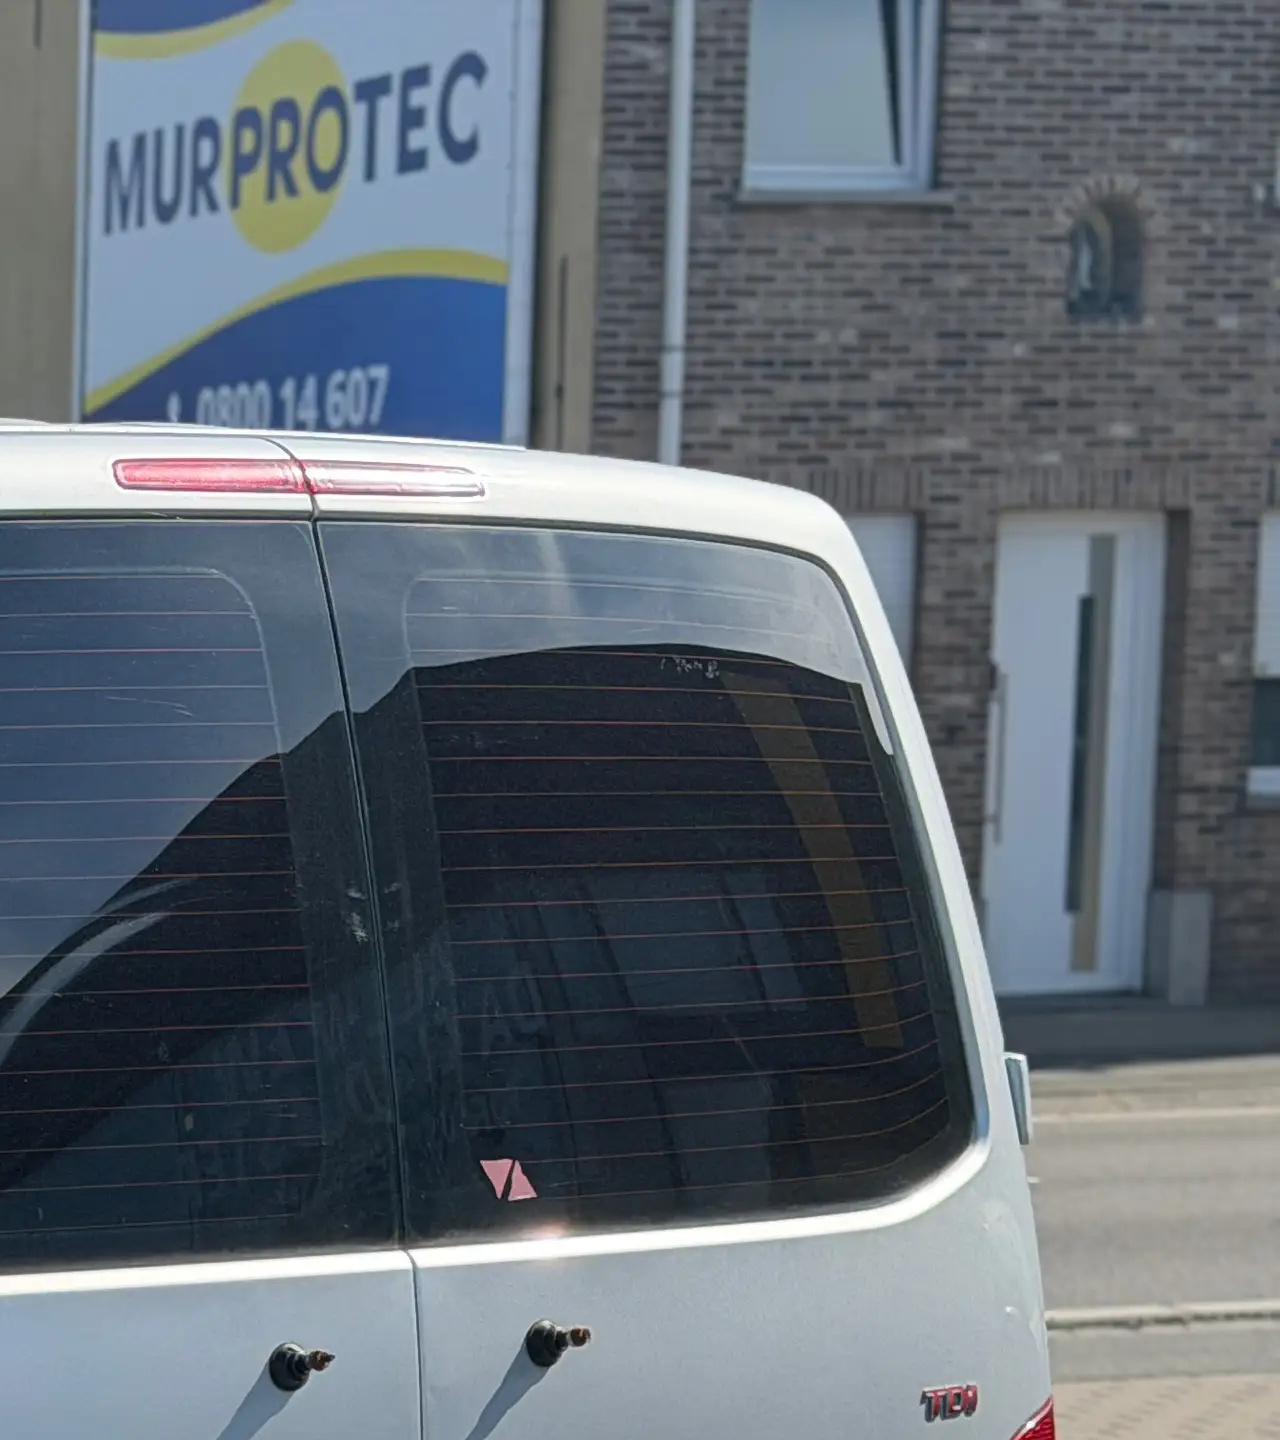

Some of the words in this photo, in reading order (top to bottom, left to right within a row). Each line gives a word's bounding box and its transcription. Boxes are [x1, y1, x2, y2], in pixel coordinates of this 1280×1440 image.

[103, 50, 488, 236] MURPROTEC
[279, 373, 318, 431] 14
[325, 363, 389, 429] 607
[920, 1383, 978, 1423] TDI
